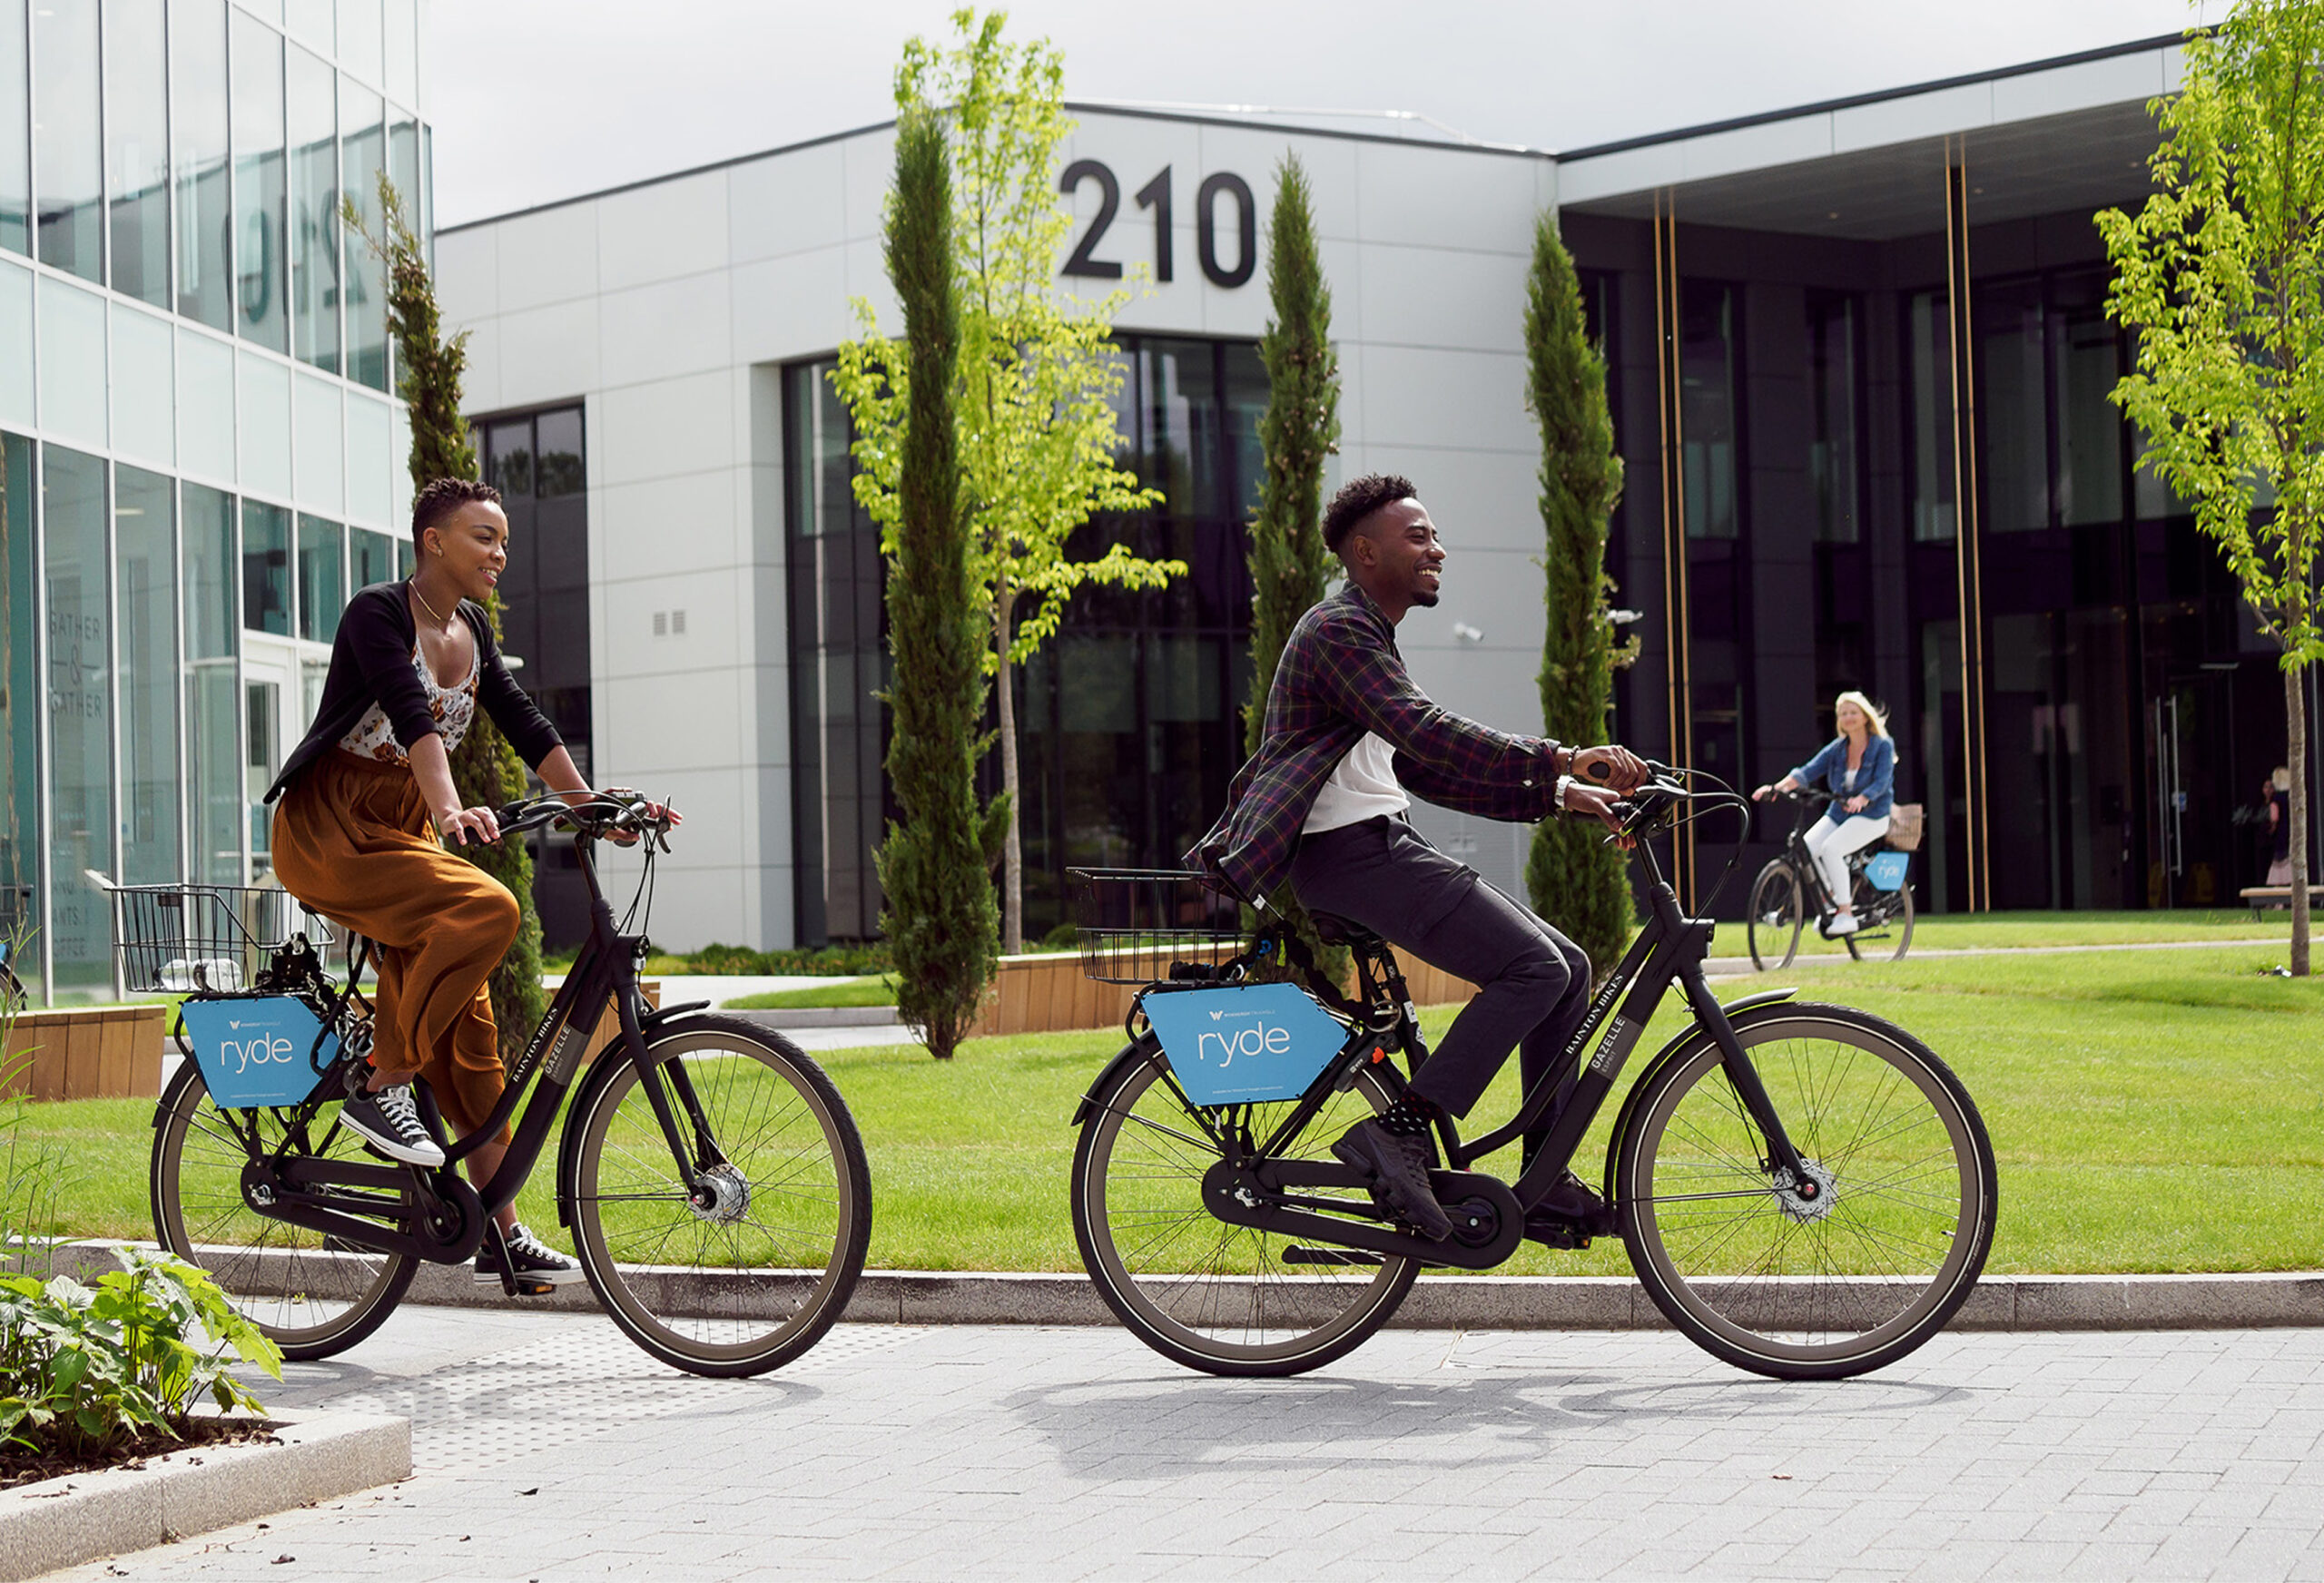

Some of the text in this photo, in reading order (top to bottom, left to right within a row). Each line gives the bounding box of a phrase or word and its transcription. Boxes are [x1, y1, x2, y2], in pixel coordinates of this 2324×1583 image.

[1059, 158, 1256, 289] 210
[49, 611, 100, 640] GATHER
[1566, 974, 1623, 1055] BAINTON BIKES
[221, 1031, 293, 1075] ryde
[513, 1008, 558, 1083] BAINTON BIKES
[545, 1025, 571, 1075] GAZELLE
[1198, 1020, 1290, 1067] ryde
[1590, 1016, 1626, 1069] GAZELLE
